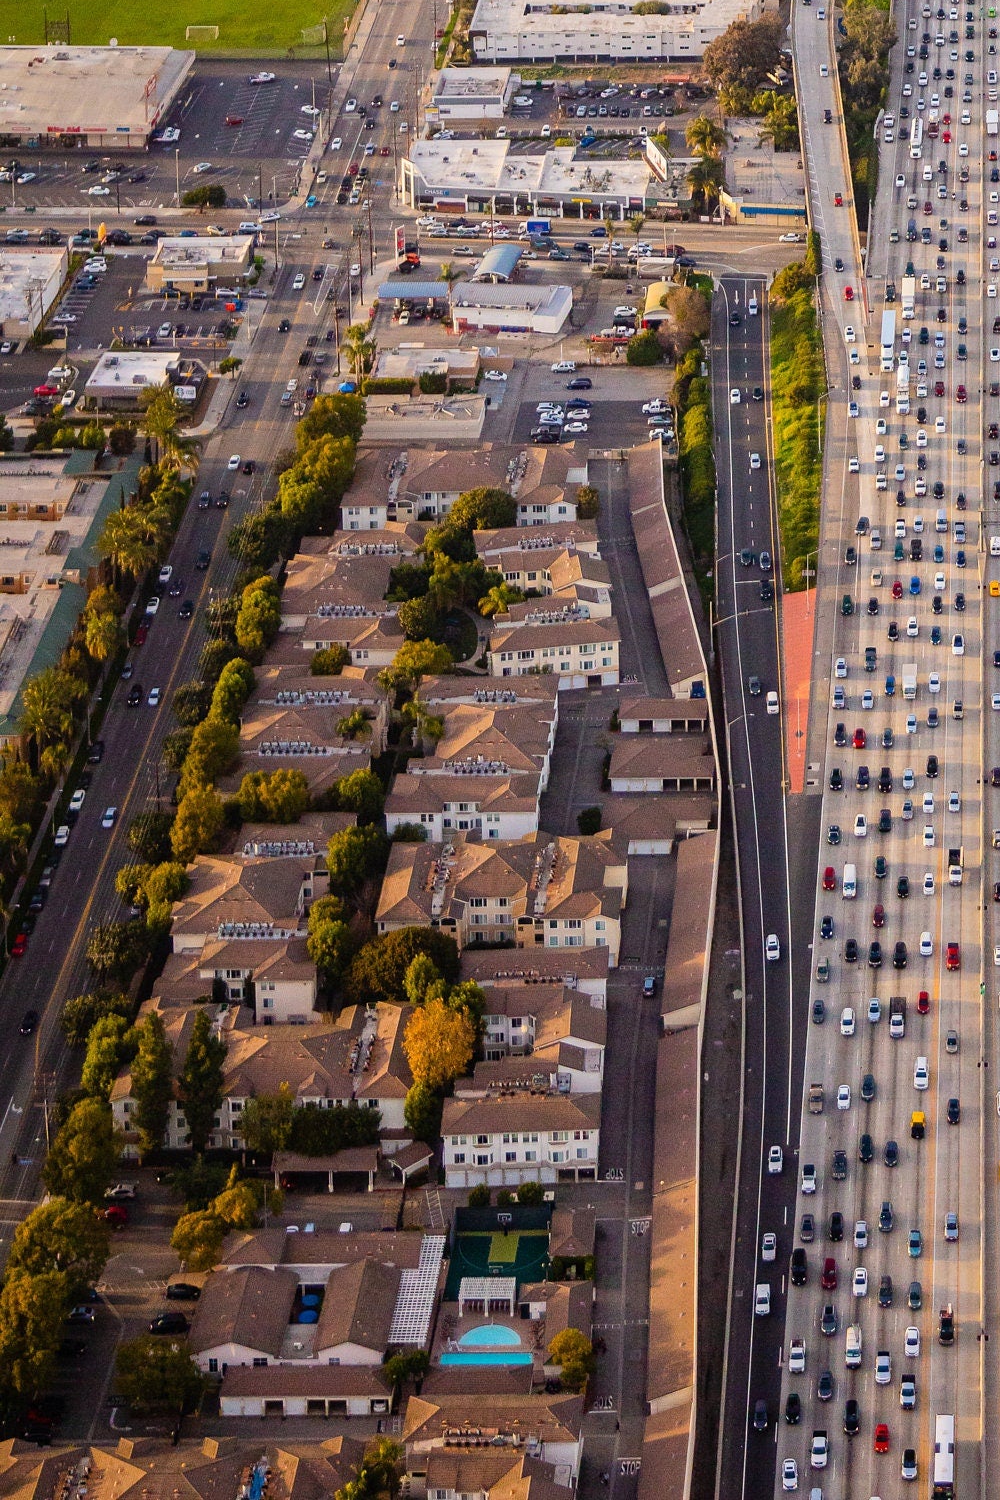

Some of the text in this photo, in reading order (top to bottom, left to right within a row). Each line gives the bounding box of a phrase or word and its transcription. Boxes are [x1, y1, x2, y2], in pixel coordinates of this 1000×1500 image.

[605, 1168, 624, 1180] STOP
[631, 1221, 650, 1234] STOP
[620, 1461, 641, 1476] STOP
